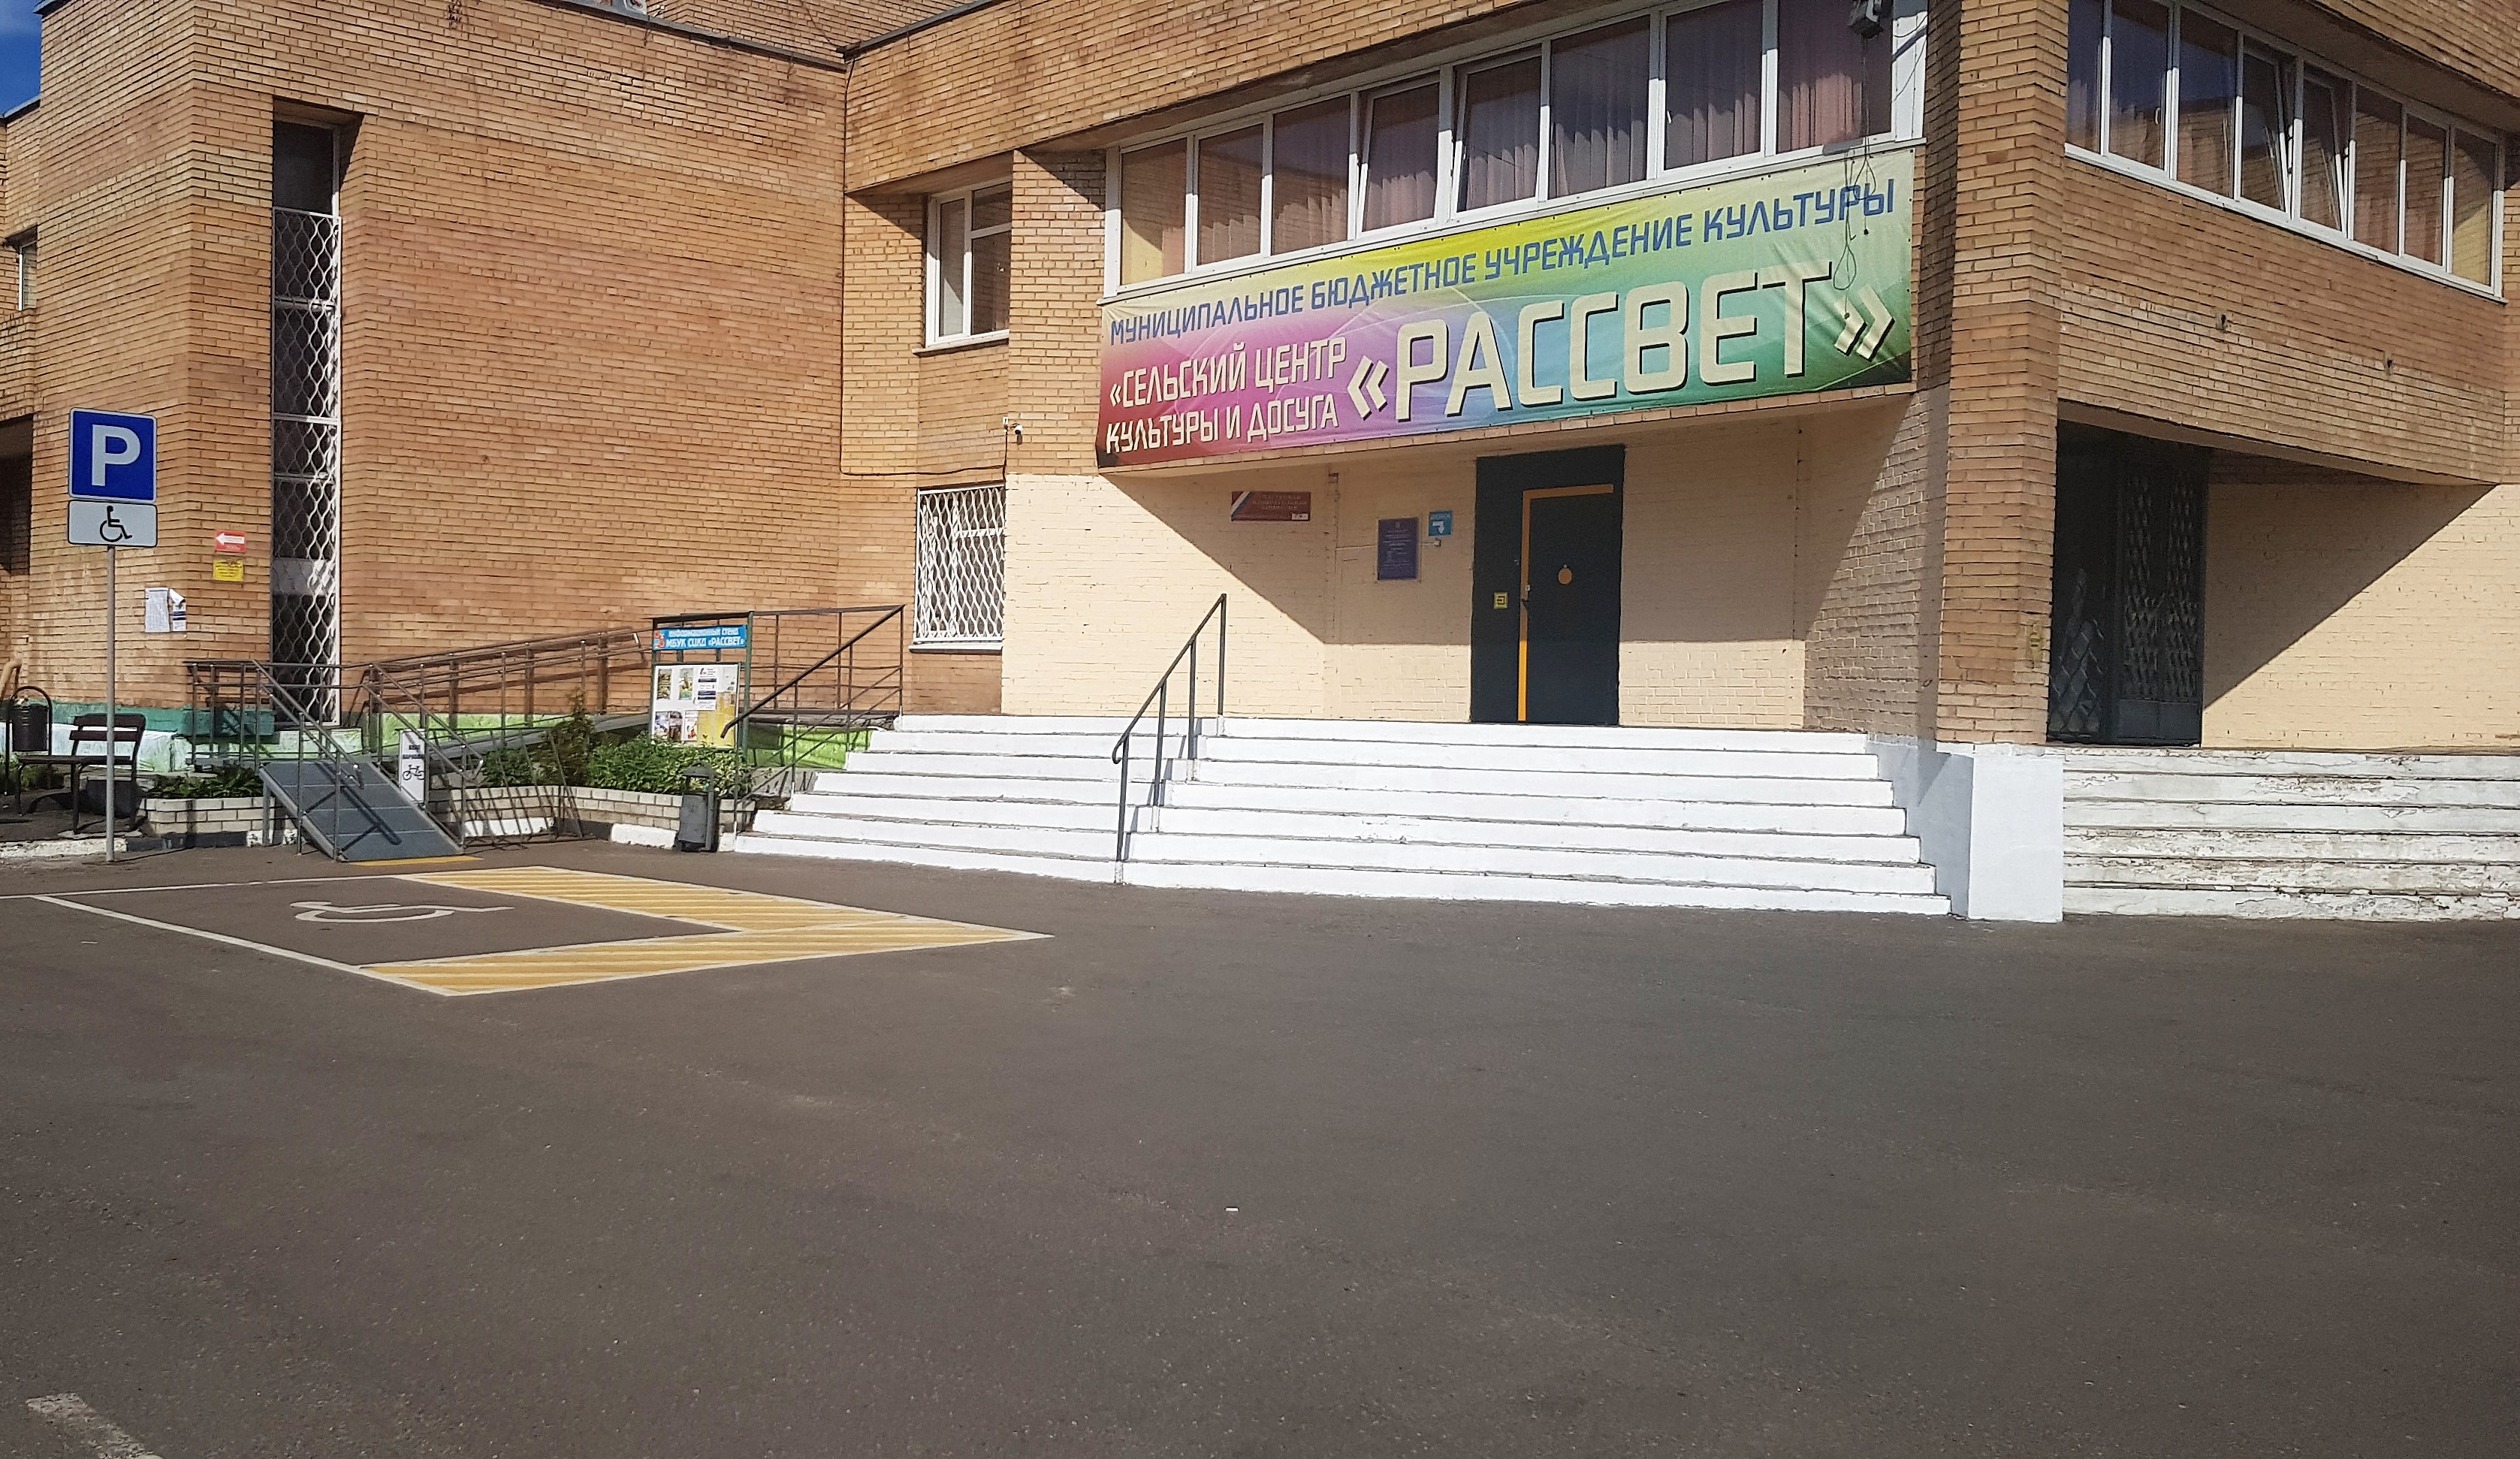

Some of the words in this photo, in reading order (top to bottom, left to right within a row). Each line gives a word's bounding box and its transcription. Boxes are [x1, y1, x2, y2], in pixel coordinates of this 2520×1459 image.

[1110, 285, 1304, 346] МУНИЦИПАЛЬНОЕ
[1311, 252, 1477, 309] БЮДЖЕТНОЕ
[1484, 213, 1693, 280] УЧРЕЖДЕНИЕ
[1704, 178, 1895, 240] КУЛЬТУРЫ
[1109, 341, 1247, 408] «СЕЛЬСКИЙ
[1254, 337, 1348, 394] ЦЕНТР
[1346, 261, 1896, 423] «РАССВЕТ»
[91, 424, 141, 487] P
[1106, 408, 1220, 454] КУЛЬТУРЫ
[1226, 405, 1242, 440] И
[1247, 393, 1339, 443] ДОСУГА
